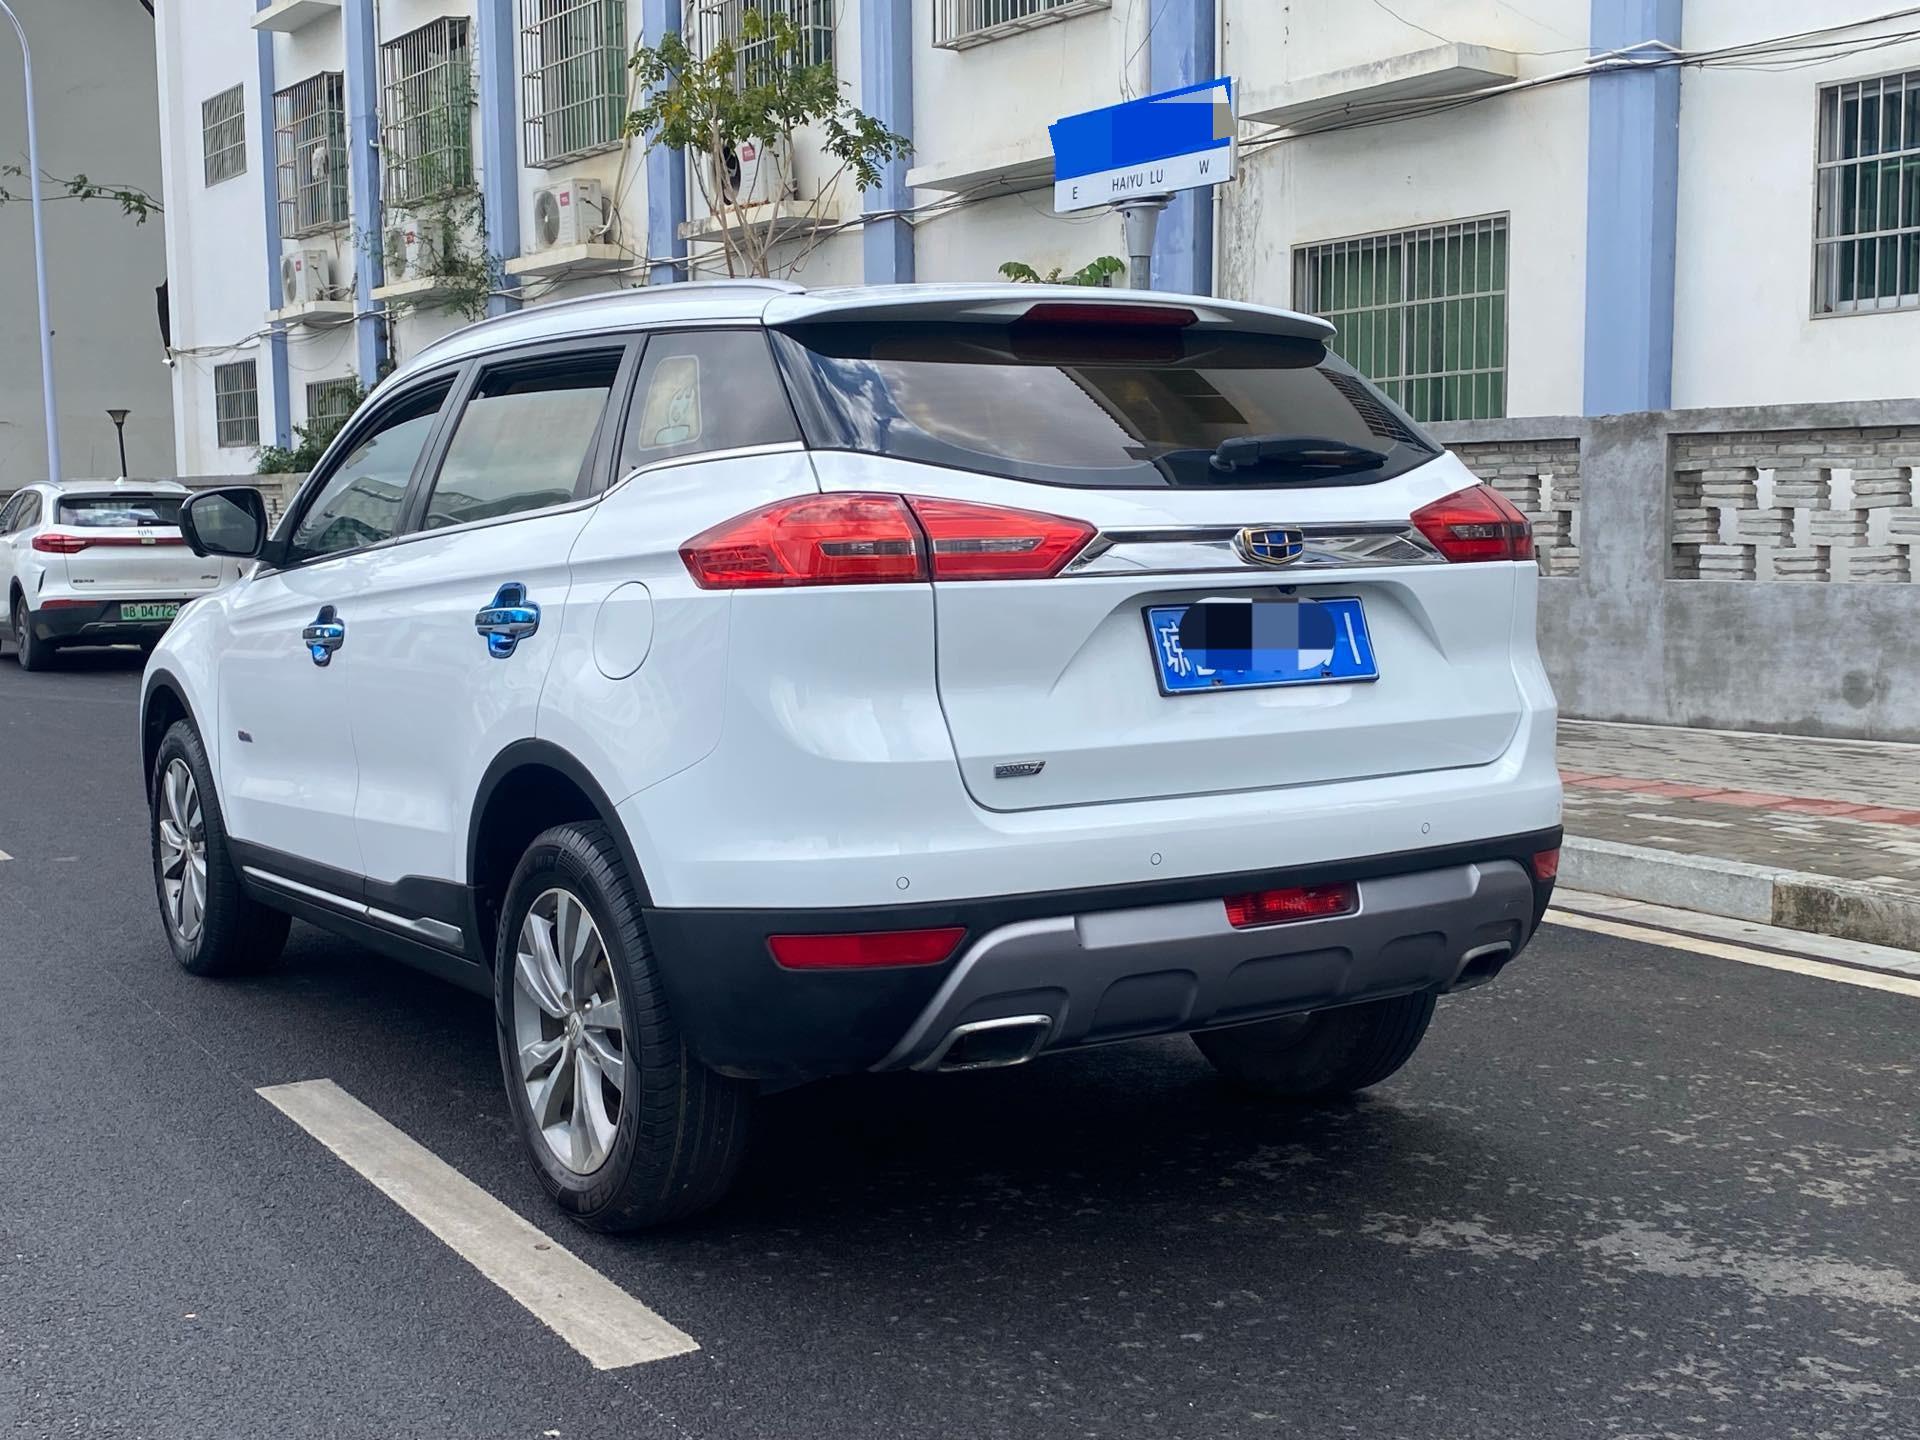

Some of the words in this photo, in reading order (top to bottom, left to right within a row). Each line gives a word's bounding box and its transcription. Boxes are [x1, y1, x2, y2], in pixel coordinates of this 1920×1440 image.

[1072, 187, 1078, 200] E
[1112, 173, 1143, 191] HAIYU
[1150, 169, 1164, 185] LU
[1199, 159, 1210, 175] W
